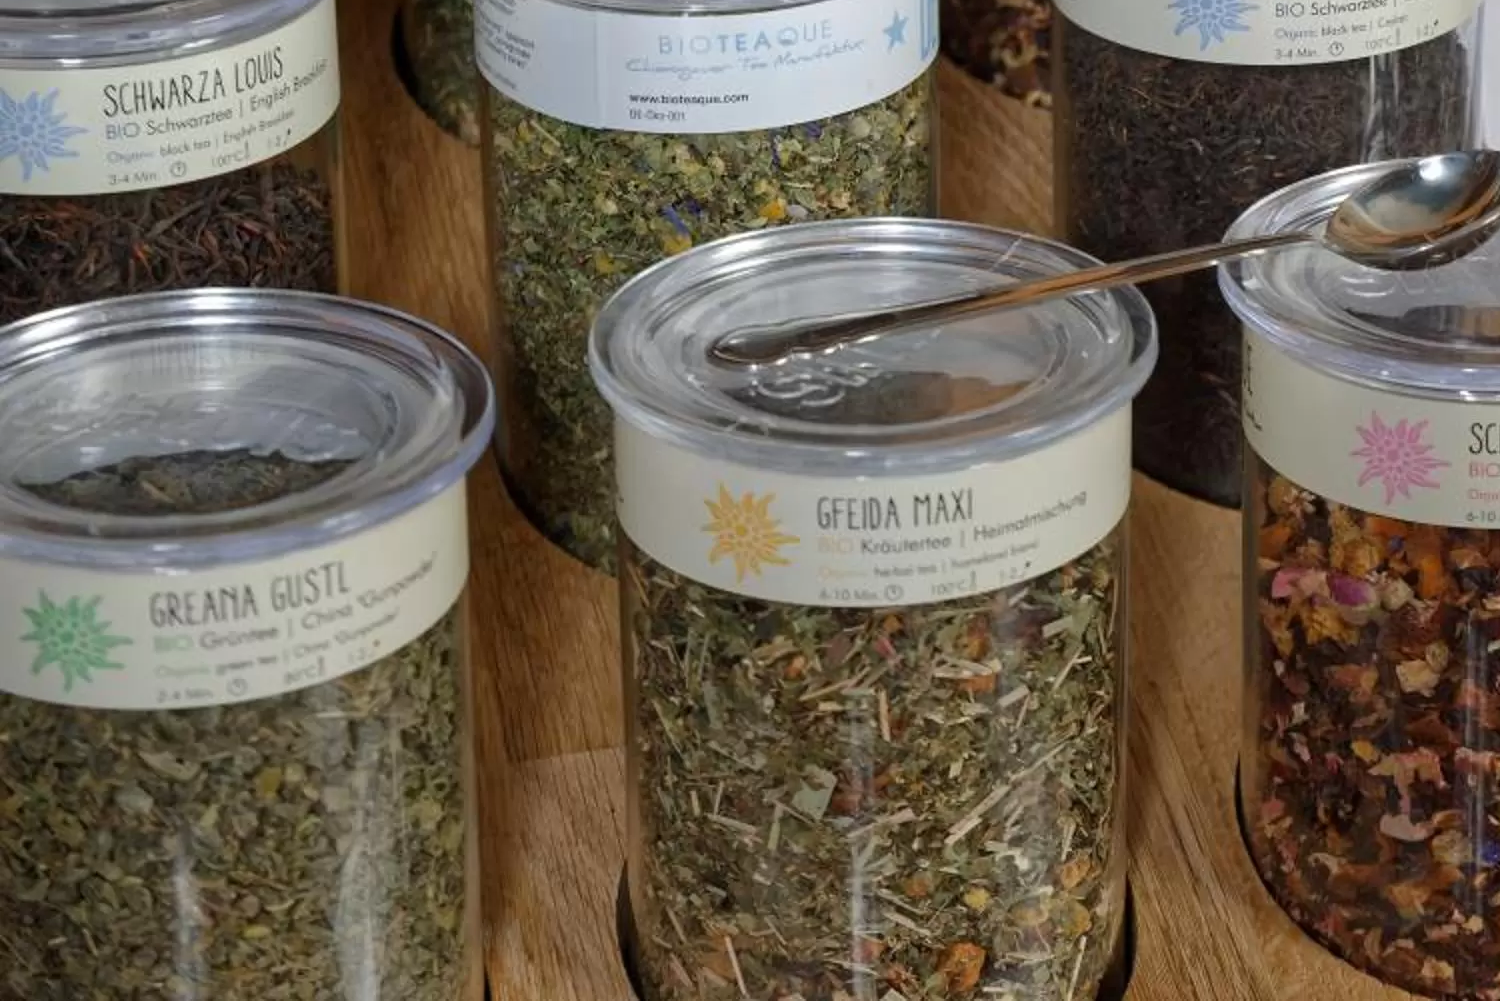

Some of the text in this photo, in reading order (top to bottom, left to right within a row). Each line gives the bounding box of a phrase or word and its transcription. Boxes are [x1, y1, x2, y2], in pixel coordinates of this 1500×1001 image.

[1275, 2, 1305, 18] BIO
[658, 19, 833, 55] BIOTEAQUE
[103, 46, 284, 119] SCHWARZA LOUIS
[629, 94, 750, 107] www.bioteaque.com
[105, 122, 141, 141] BIO
[145, 107, 233, 136] Schwarztee
[250, 83, 291, 112] English
[815, 487, 974, 531] GFEIDA MAXI
[860, 535, 953, 555] Kräutertee
[149, 560, 351, 628] GREANA GUSTL
